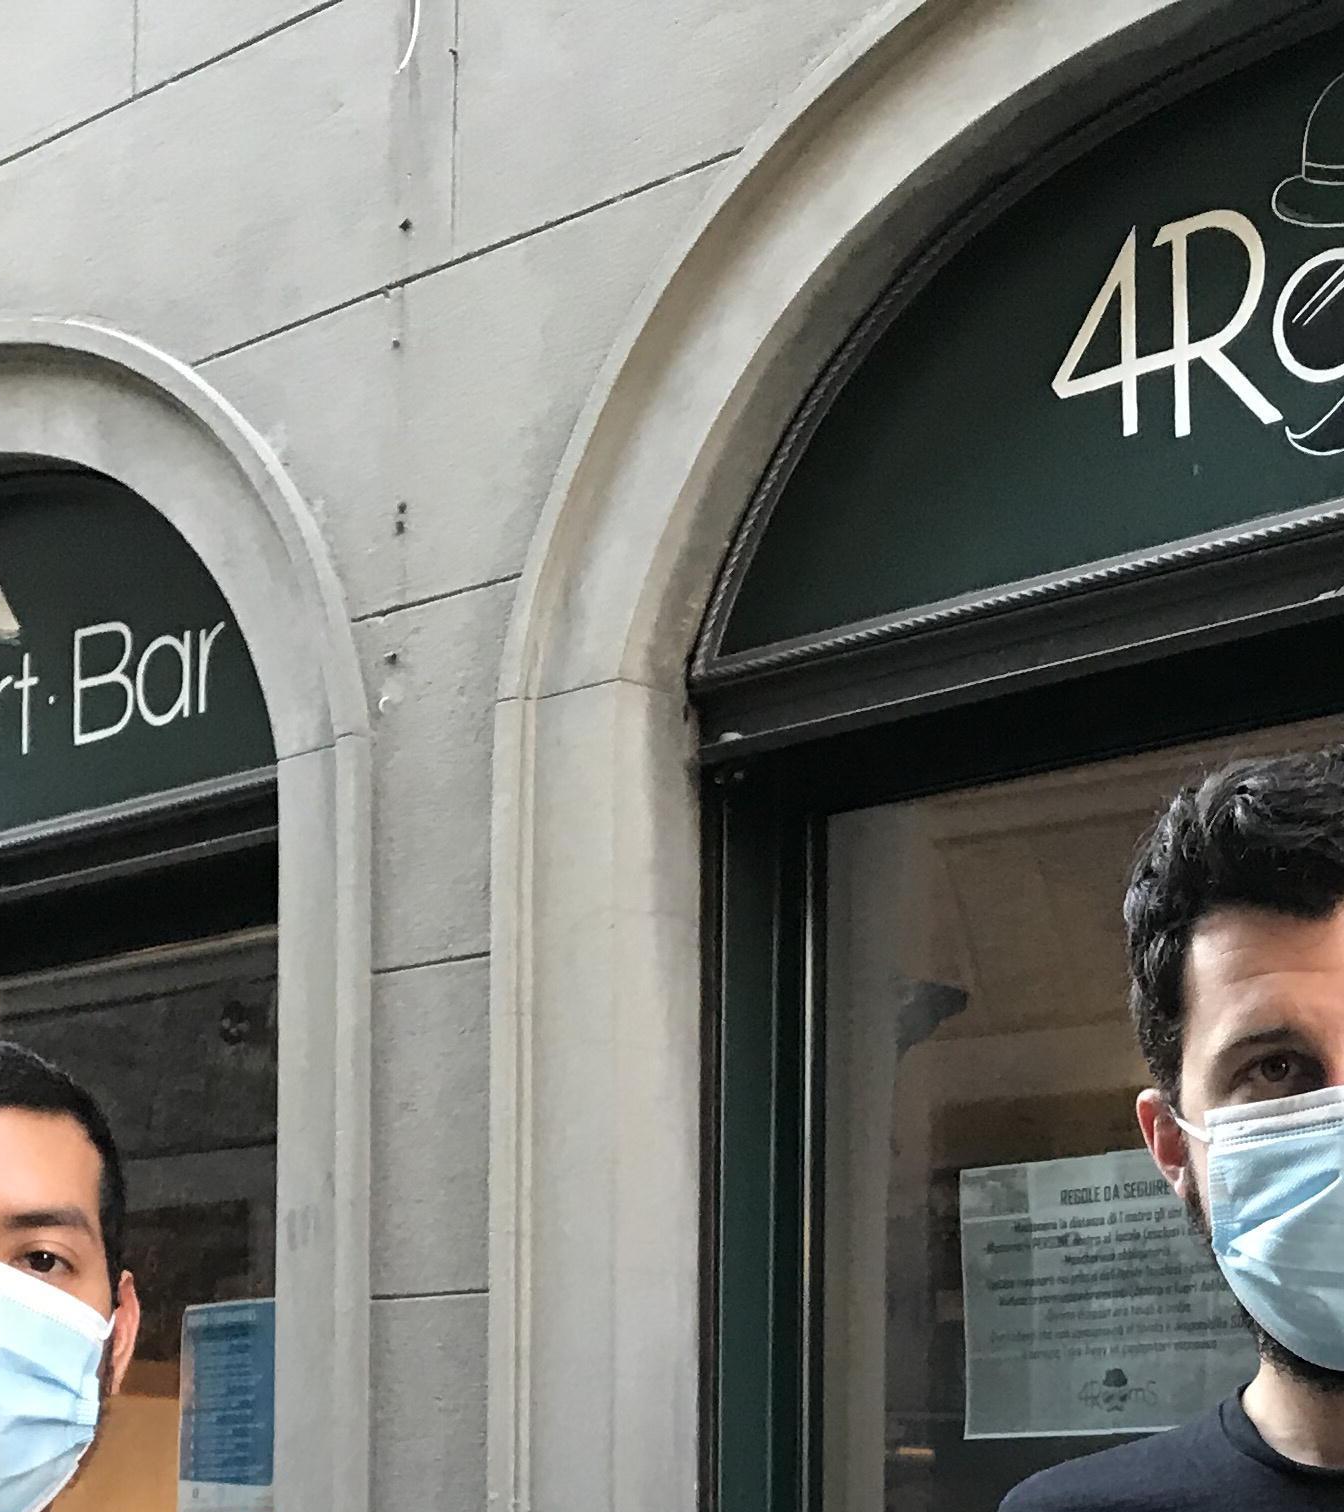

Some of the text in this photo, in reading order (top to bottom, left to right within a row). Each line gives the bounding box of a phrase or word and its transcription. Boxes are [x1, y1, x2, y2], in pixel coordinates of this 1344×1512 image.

[73, 621, 225, 746] Bar
[1060, 1185, 1101, 1205] REGOLE
[1123, 1178, 1170, 1198] SEGUIRE
